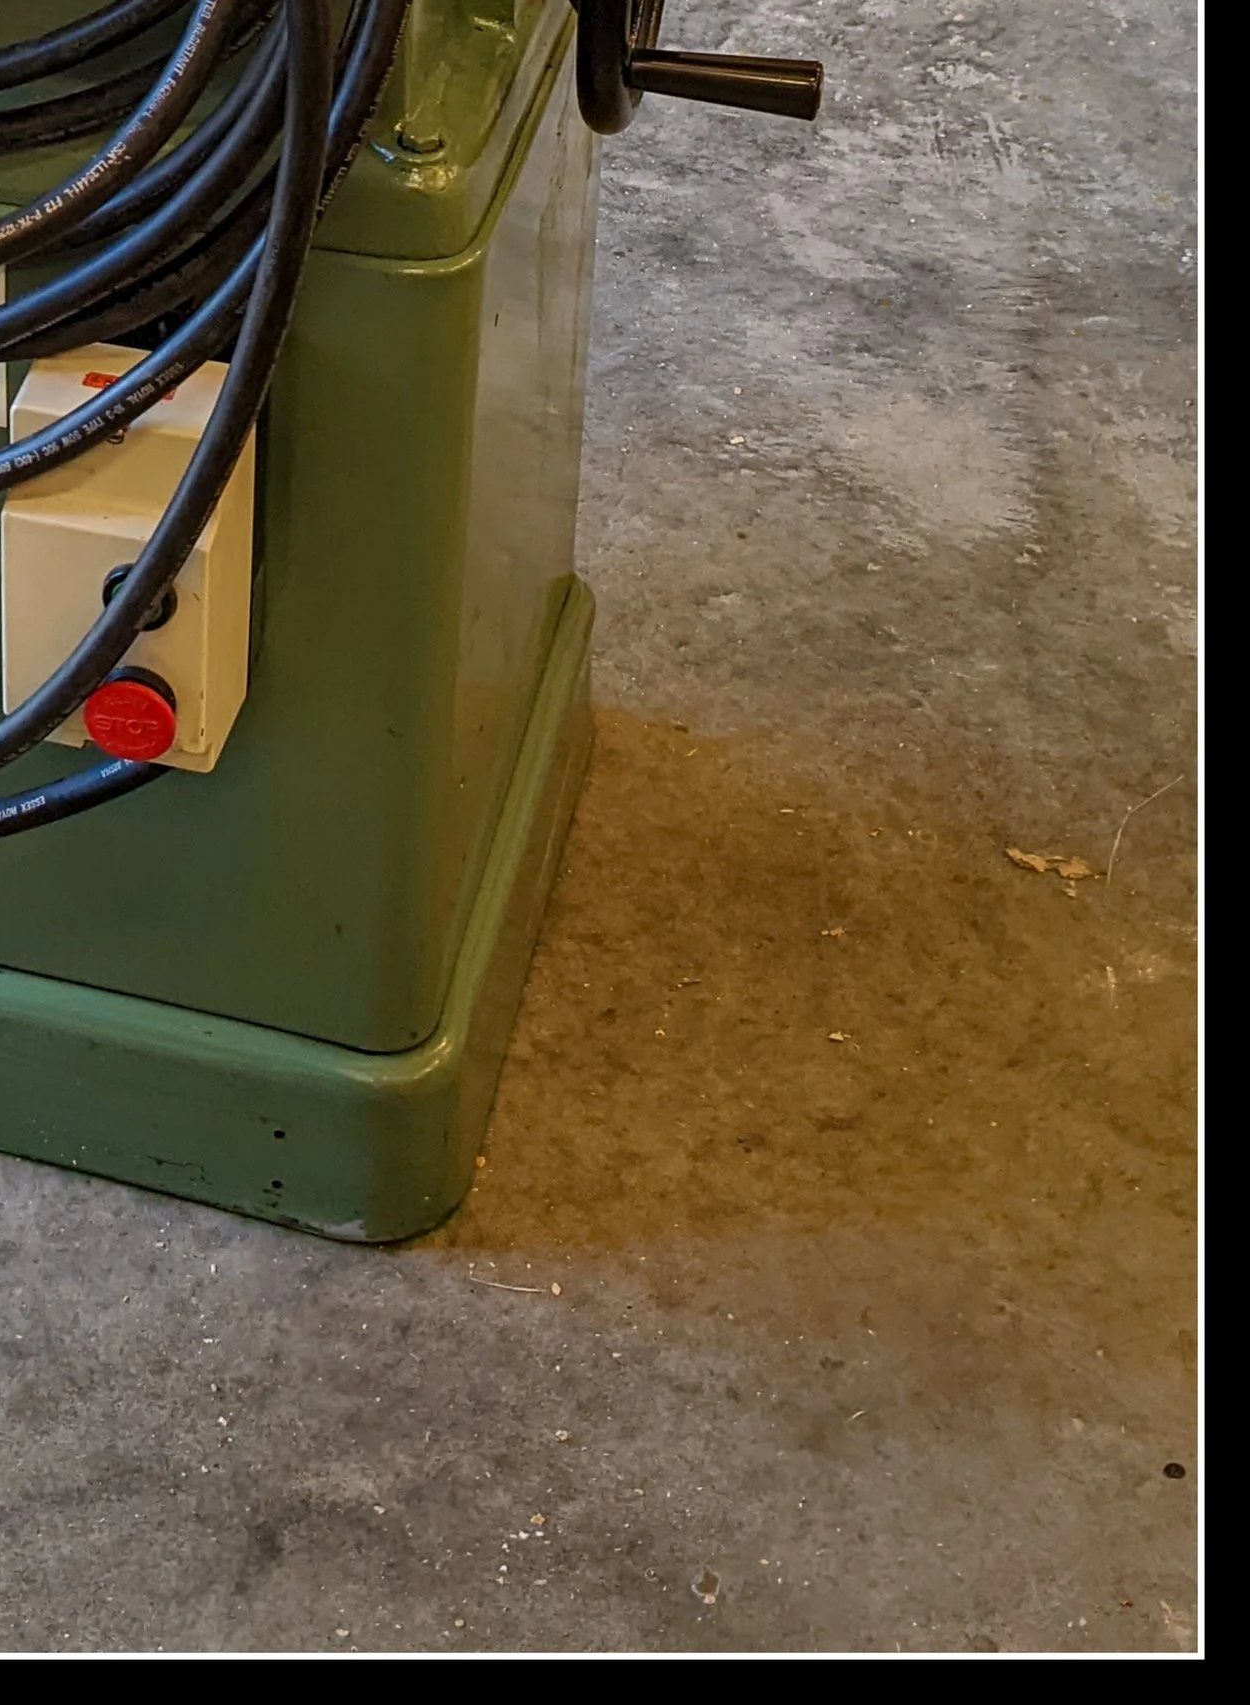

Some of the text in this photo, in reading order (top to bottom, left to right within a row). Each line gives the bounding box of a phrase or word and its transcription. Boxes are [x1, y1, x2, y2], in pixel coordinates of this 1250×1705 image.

[81, 417, 104, 435] TYPE
[61, 429, 82, 446] SOW
[13, 449, 40, 467] (-40C)
[95, 715, 158, 735] STOP
[20, 796, 46, 812] ESSEX
